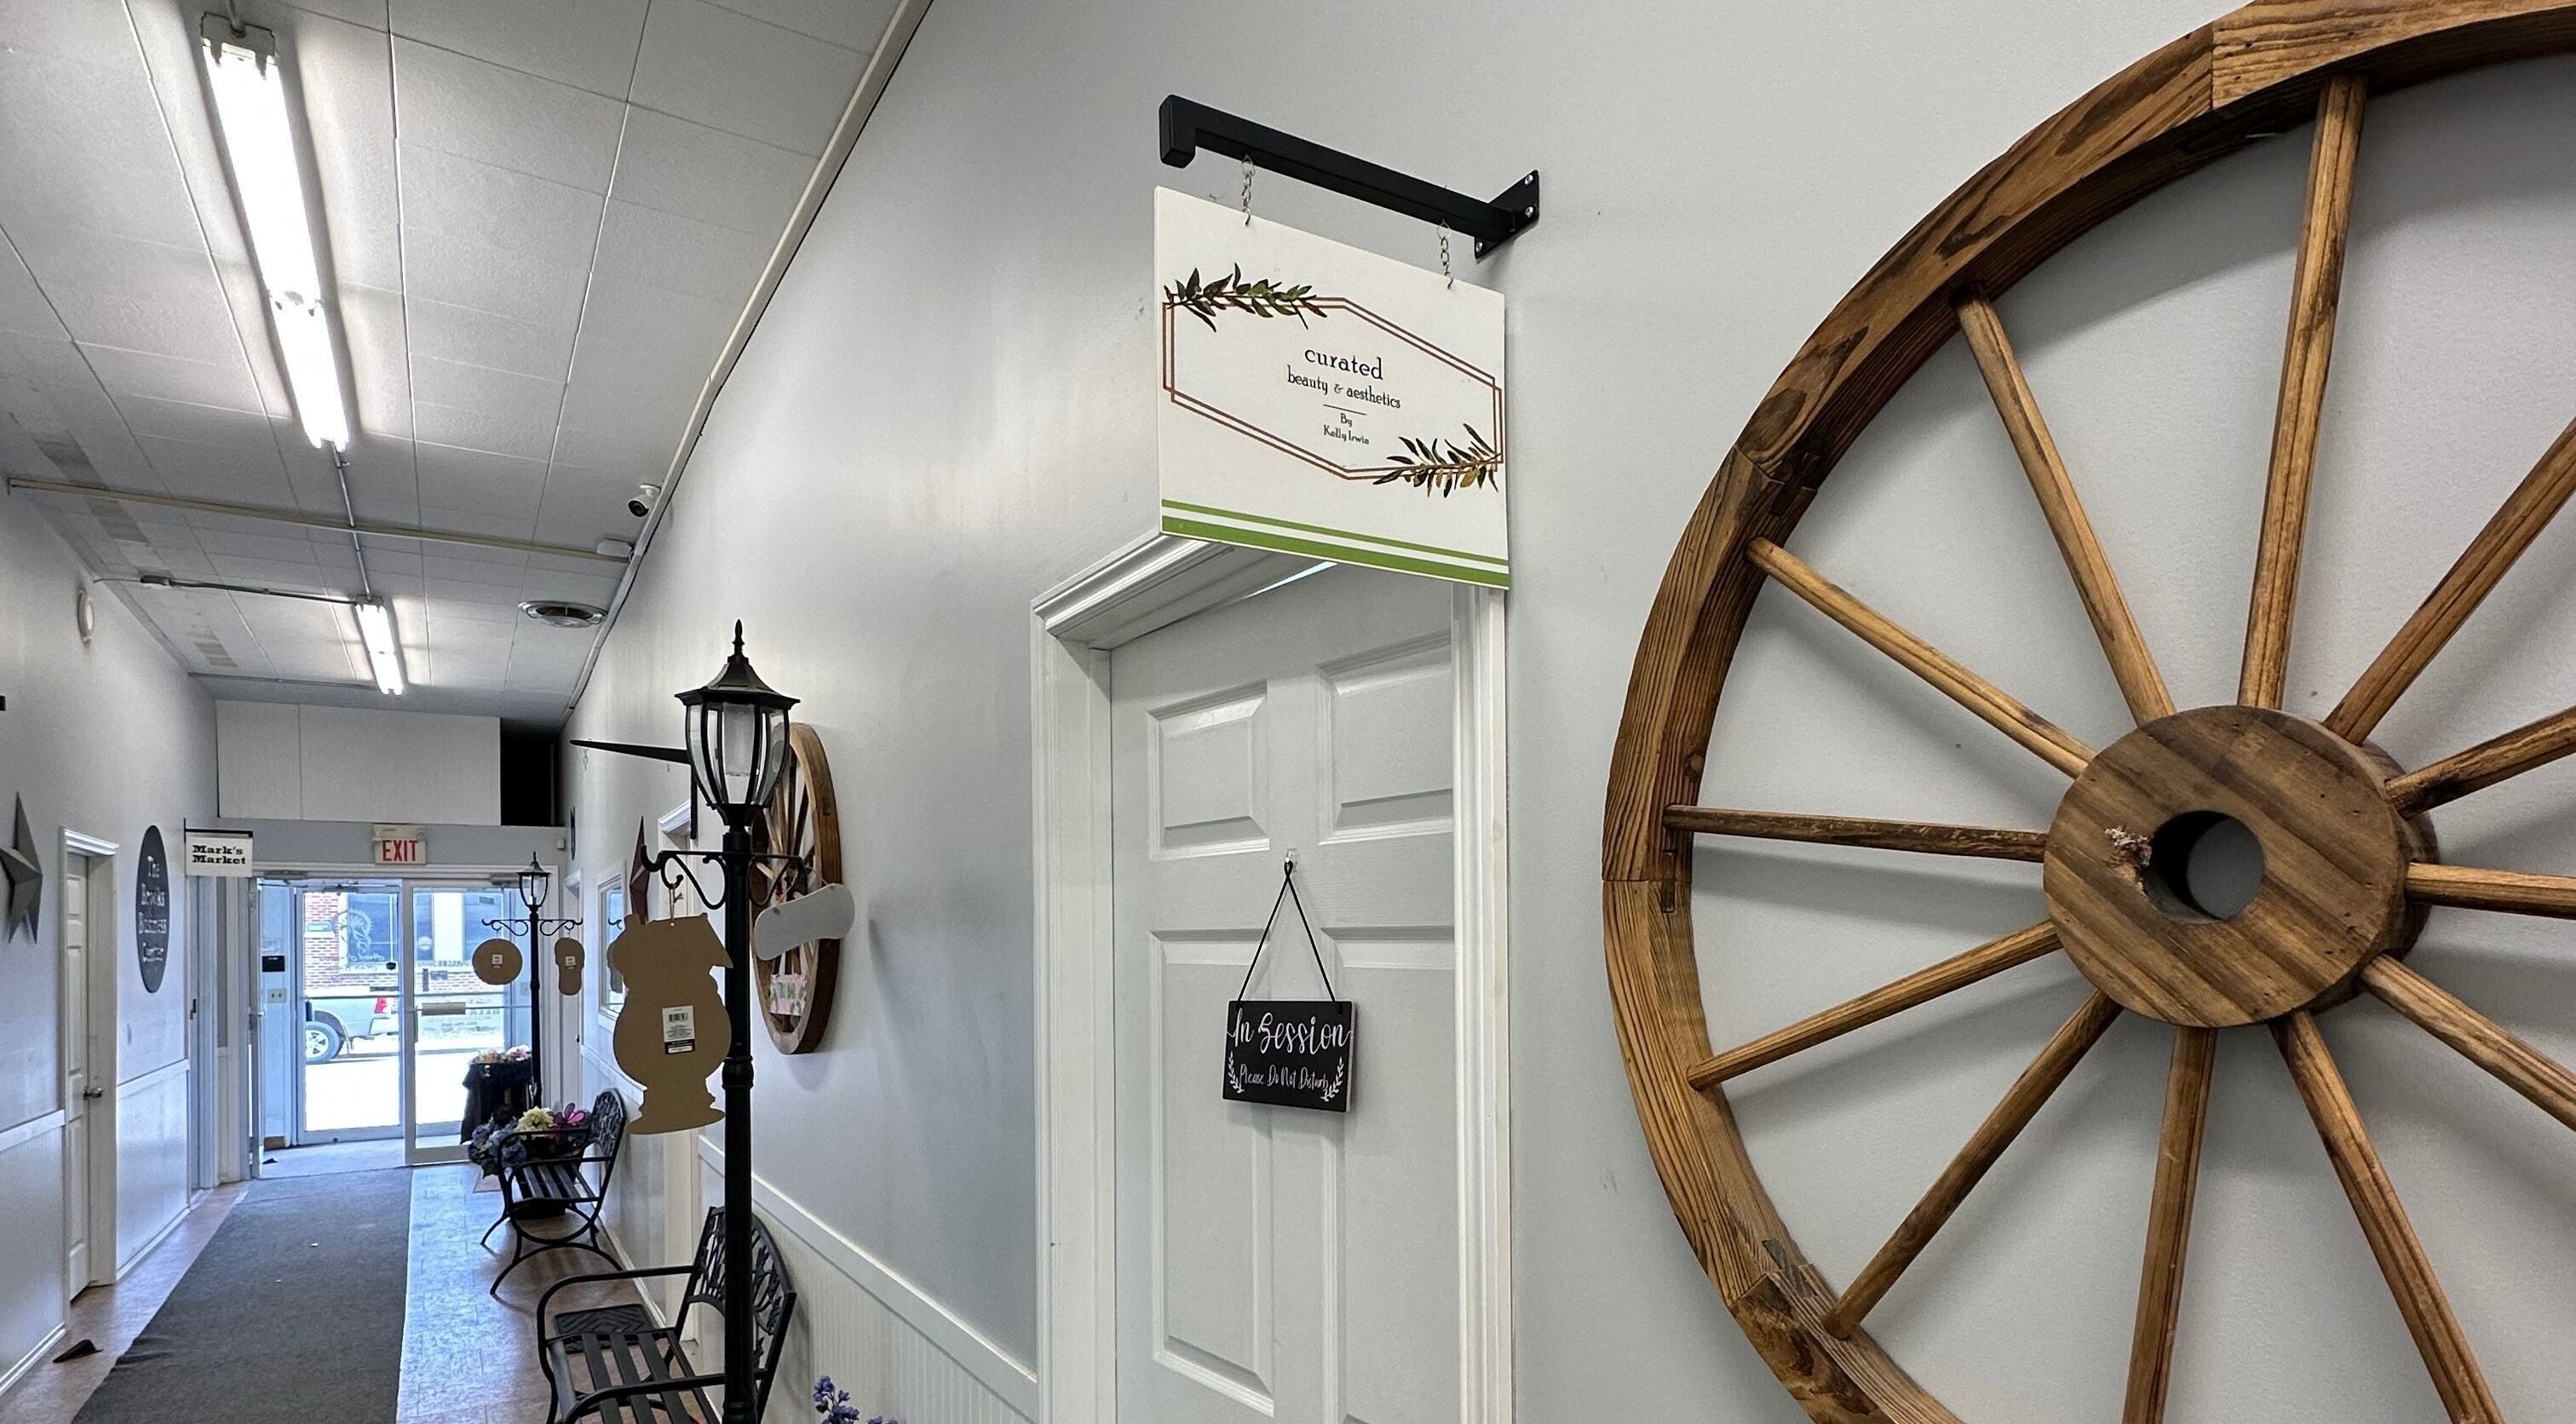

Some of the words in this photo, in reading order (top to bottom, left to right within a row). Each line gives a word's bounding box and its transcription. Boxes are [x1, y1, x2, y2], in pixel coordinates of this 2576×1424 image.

[1304, 349, 1383, 380] curated
[1287, 365, 1328, 395] beauty
[1346, 385, 1401, 409] aesthetics
[1340, 412, 1353, 427] By
[1323, 425, 1347, 442] Kelly
[1348, 430, 1370, 445] Irwin
[193, 845, 244, 855] Mark's
[193, 854, 246, 864] Market
[382, 840, 419, 862] EXIT
[1227, 1008, 1255, 1048] In
[1258, 1013, 1352, 1054] Session
[1238, 1064, 1265, 1091] Please
[1267, 1065, 1279, 1087] Do
[1280, 1066, 1297, 1088] Not
[1298, 1066, 1330, 1091] Disturb
